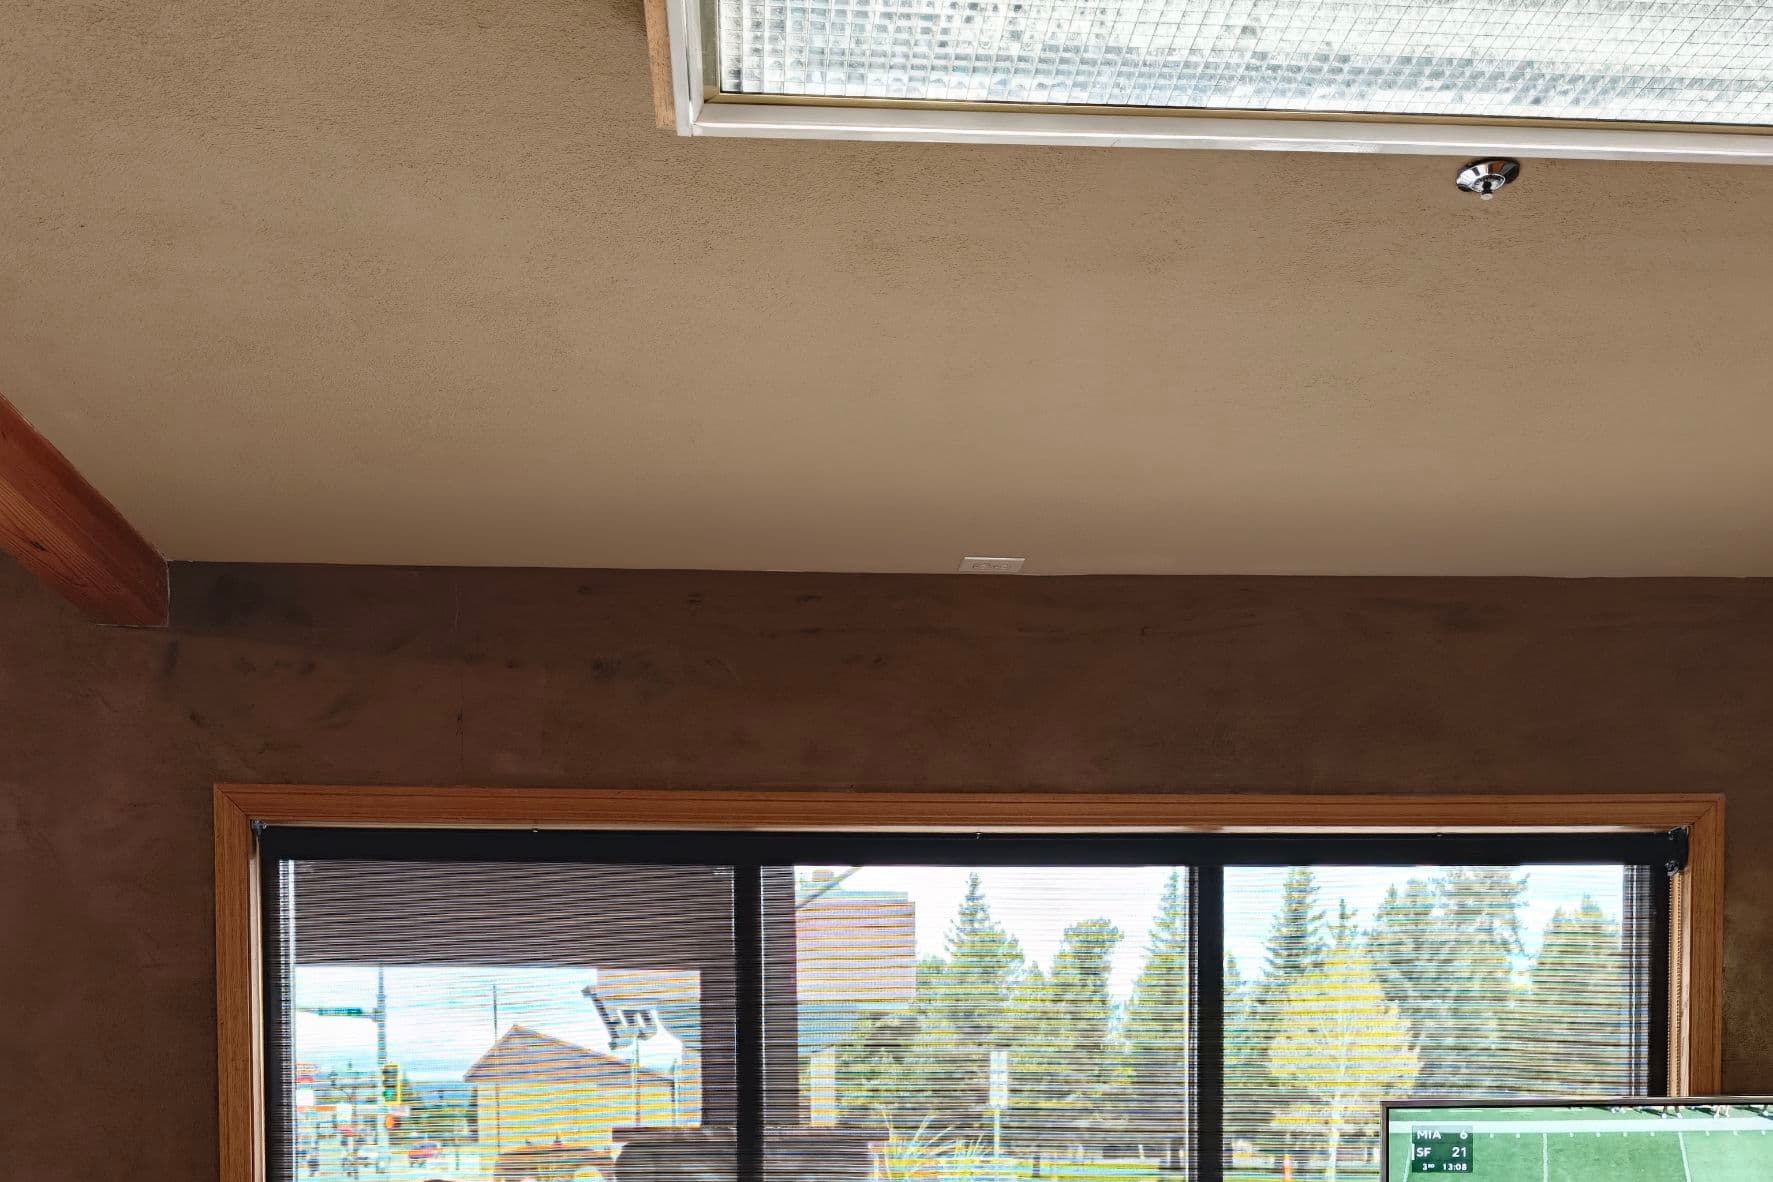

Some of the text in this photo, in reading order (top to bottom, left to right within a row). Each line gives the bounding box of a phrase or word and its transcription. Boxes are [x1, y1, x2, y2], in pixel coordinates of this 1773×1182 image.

[1416, 1129, 1468, 1140] MIA 6
[1416, 1146, 1467, 1158] SF 21
